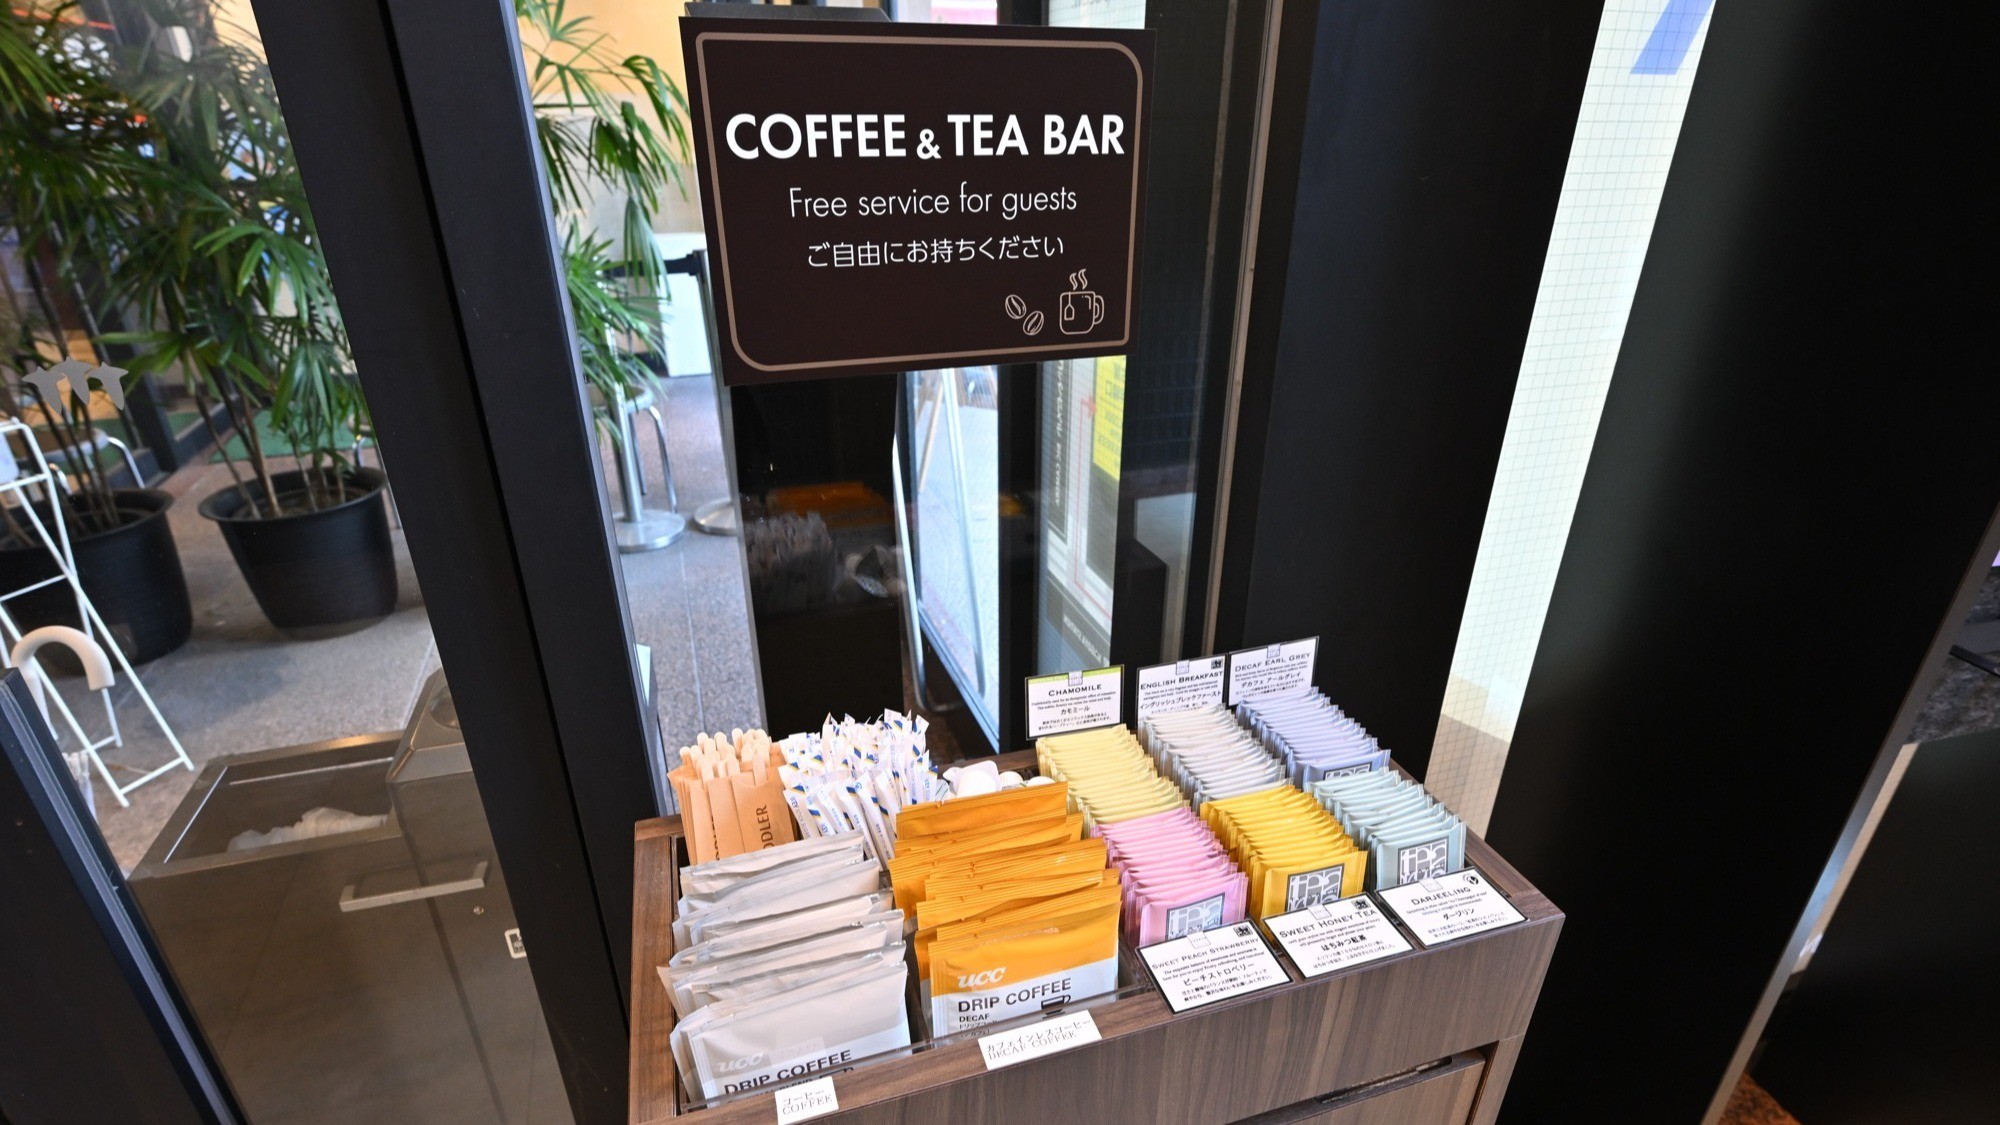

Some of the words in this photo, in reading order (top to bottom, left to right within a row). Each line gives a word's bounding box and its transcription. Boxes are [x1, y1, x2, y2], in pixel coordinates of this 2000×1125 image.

[726, 113, 906, 160] COFFEE
[916, 128, 942, 160] &
[947, 114, 1029, 157] TEA
[1043, 114, 1125, 156] BAR
[790, 187, 848, 218] Free
[858, 188, 950, 216] service
[959, 181, 993, 213] for
[1002, 186, 1078, 220] guests
[807, 236, 1065, 268] ご自由にお持ちください
[1235, 660, 1262, 672] DECAF
[1265, 657, 1287, 666] EARL
[1289, 652, 1311, 662] GREY
[1048, 684, 1102, 697] CHAMOMILE
[1140, 678, 1176, 690] ENGLISH
[1178, 670, 1224, 684] BREAKFAST
[1061, 705, 1090, 715] カモミール
[1411, 886, 1471, 906] DARJEELING
[1279, 923, 1315, 939] SWEET
[1318, 916, 1354, 929] HONEY
[1355, 909, 1377, 919] TEA
[1151, 958, 1179, 970] SWEET
[1182, 951, 1207, 962] PEACH
[1209, 938, 1260, 955] STRAWBERRY
[1320, 934, 1368, 952] はちみつ紅茶
[958, 996, 1000, 1013] DRIP
[1005, 978, 1071, 1006] COFFEE
[959, 1013, 990, 1022] DECAF
[988, 1020, 1091, 1052] カフェインレスコーヒー
[988, 1043, 1026, 1060] DECAF
[1031, 1030, 1077, 1048] COFFEE
[724, 1074, 771, 1095] DRIP
[776, 1049, 852, 1080] COFFEE
[782, 1094, 833, 1116] COFFEE
[783, 1090, 825, 1105] コーヒー
